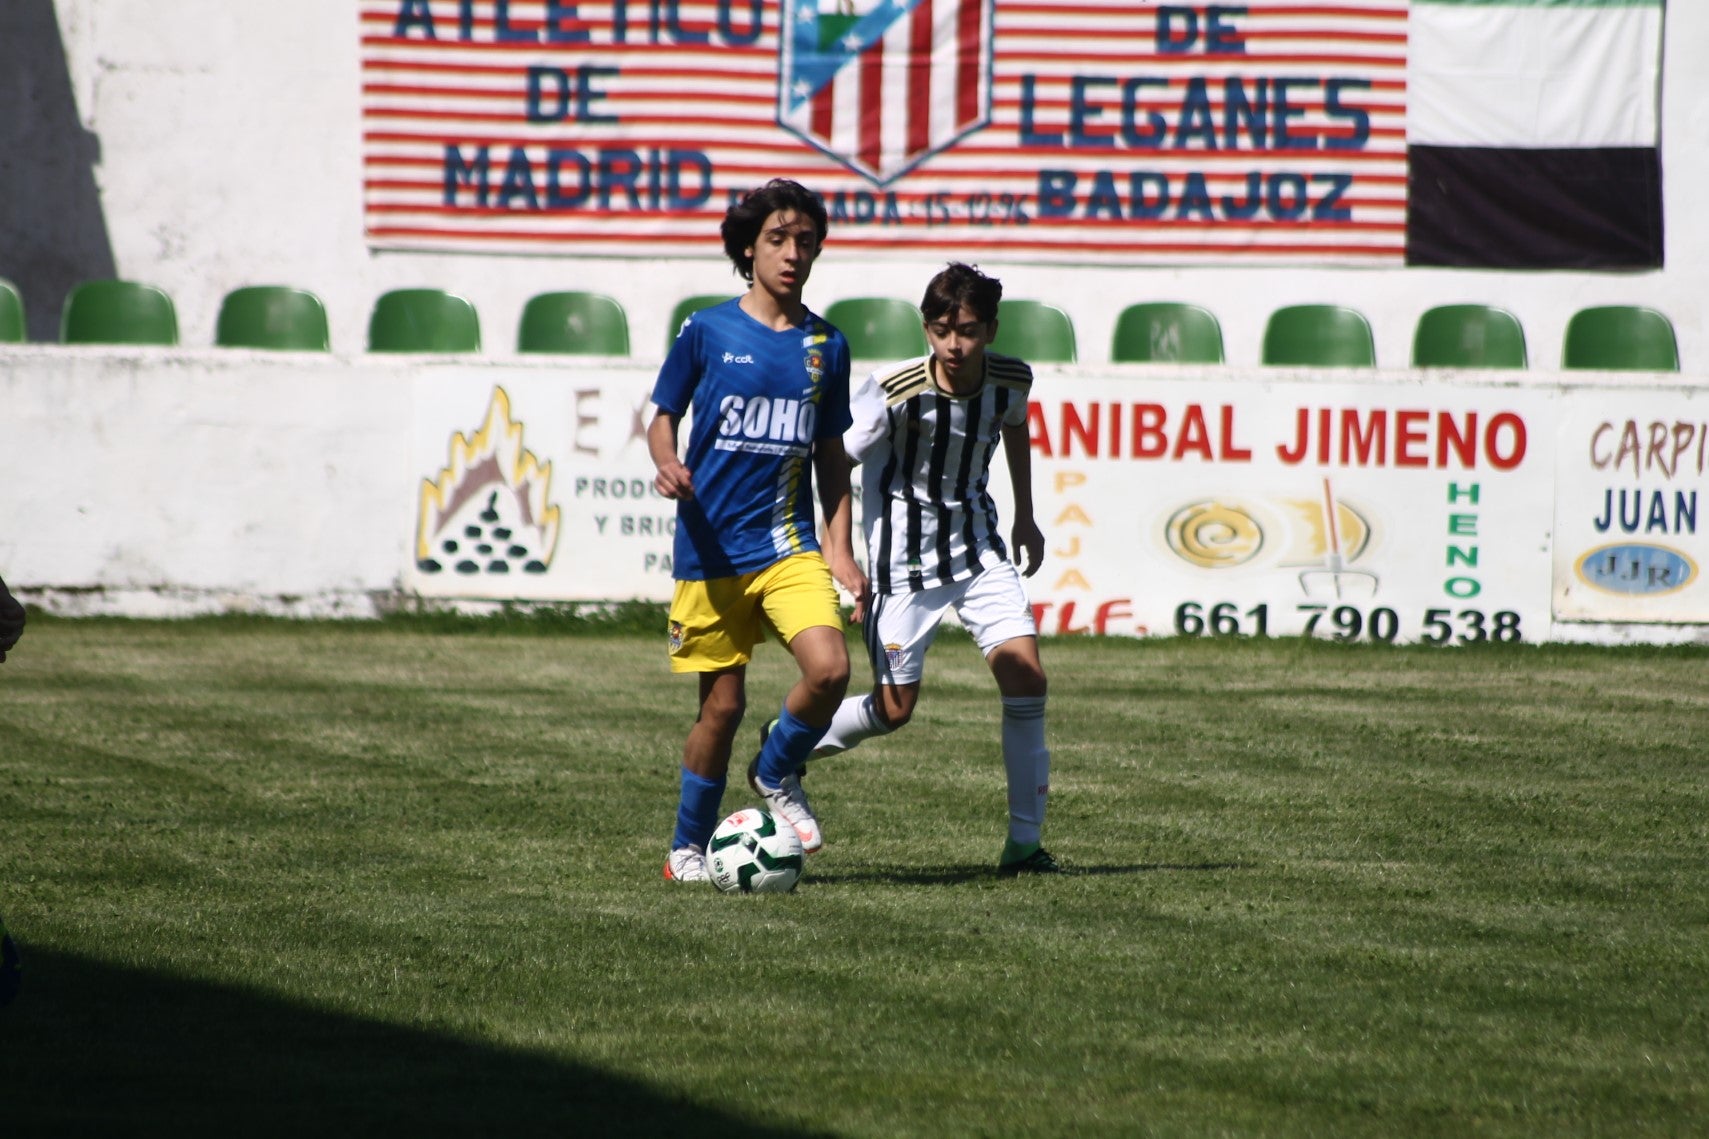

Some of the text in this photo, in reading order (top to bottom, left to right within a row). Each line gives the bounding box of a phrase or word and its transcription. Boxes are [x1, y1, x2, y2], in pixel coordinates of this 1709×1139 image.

[1154, 4, 1248, 54] DE
[526, 65, 621, 124] DE
[1019, 74, 1371, 151] LEGANES
[444, 144, 714, 211] MADRID
[1036, 169, 1353, 223] BADAJOZ
[719, 394, 816, 444] SOHO
[1025, 401, 1528, 472] ANIBAL JIMENO
[1590, 417, 1709, 480] CARPI
[594, 515, 608, 535] Y
[1594, 488, 1698, 535] JUAN
[1444, 481, 1482, 600] HENO
[1175, 601, 1269, 637] 661
[1297, 603, 1399, 641] 790
[1421, 608, 1524, 645] 538
